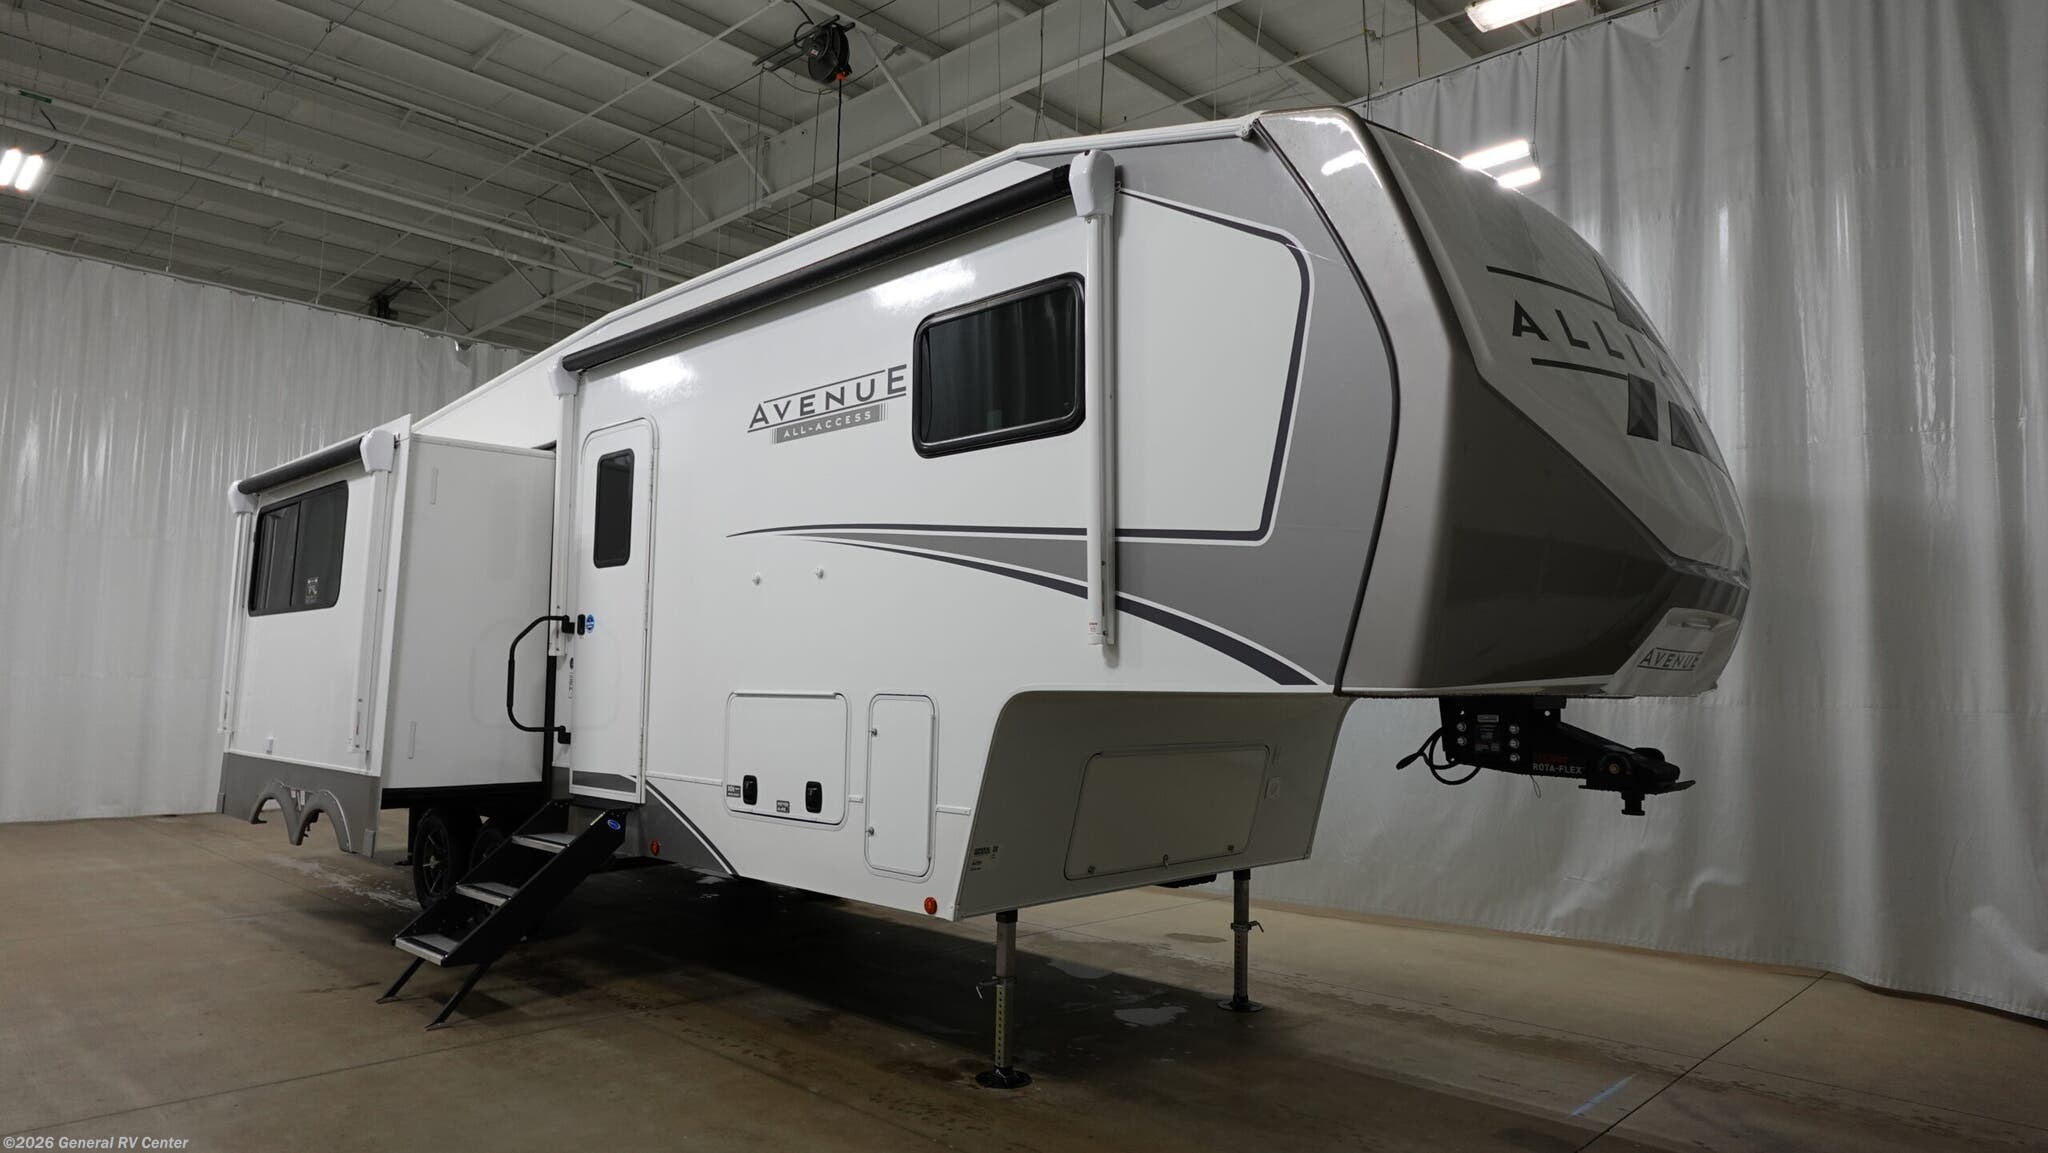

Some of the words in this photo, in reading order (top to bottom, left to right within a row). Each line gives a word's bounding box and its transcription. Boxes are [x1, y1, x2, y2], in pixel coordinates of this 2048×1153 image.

[1512, 300, 1648, 369] ALLI
[749, 364, 907, 429] AVENUE
[783, 410, 872, 438] ALL-ACCESS
[1640, 648, 1699, 669] AVENUE
[1532, 762, 1584, 775] ROTA-FLEX
